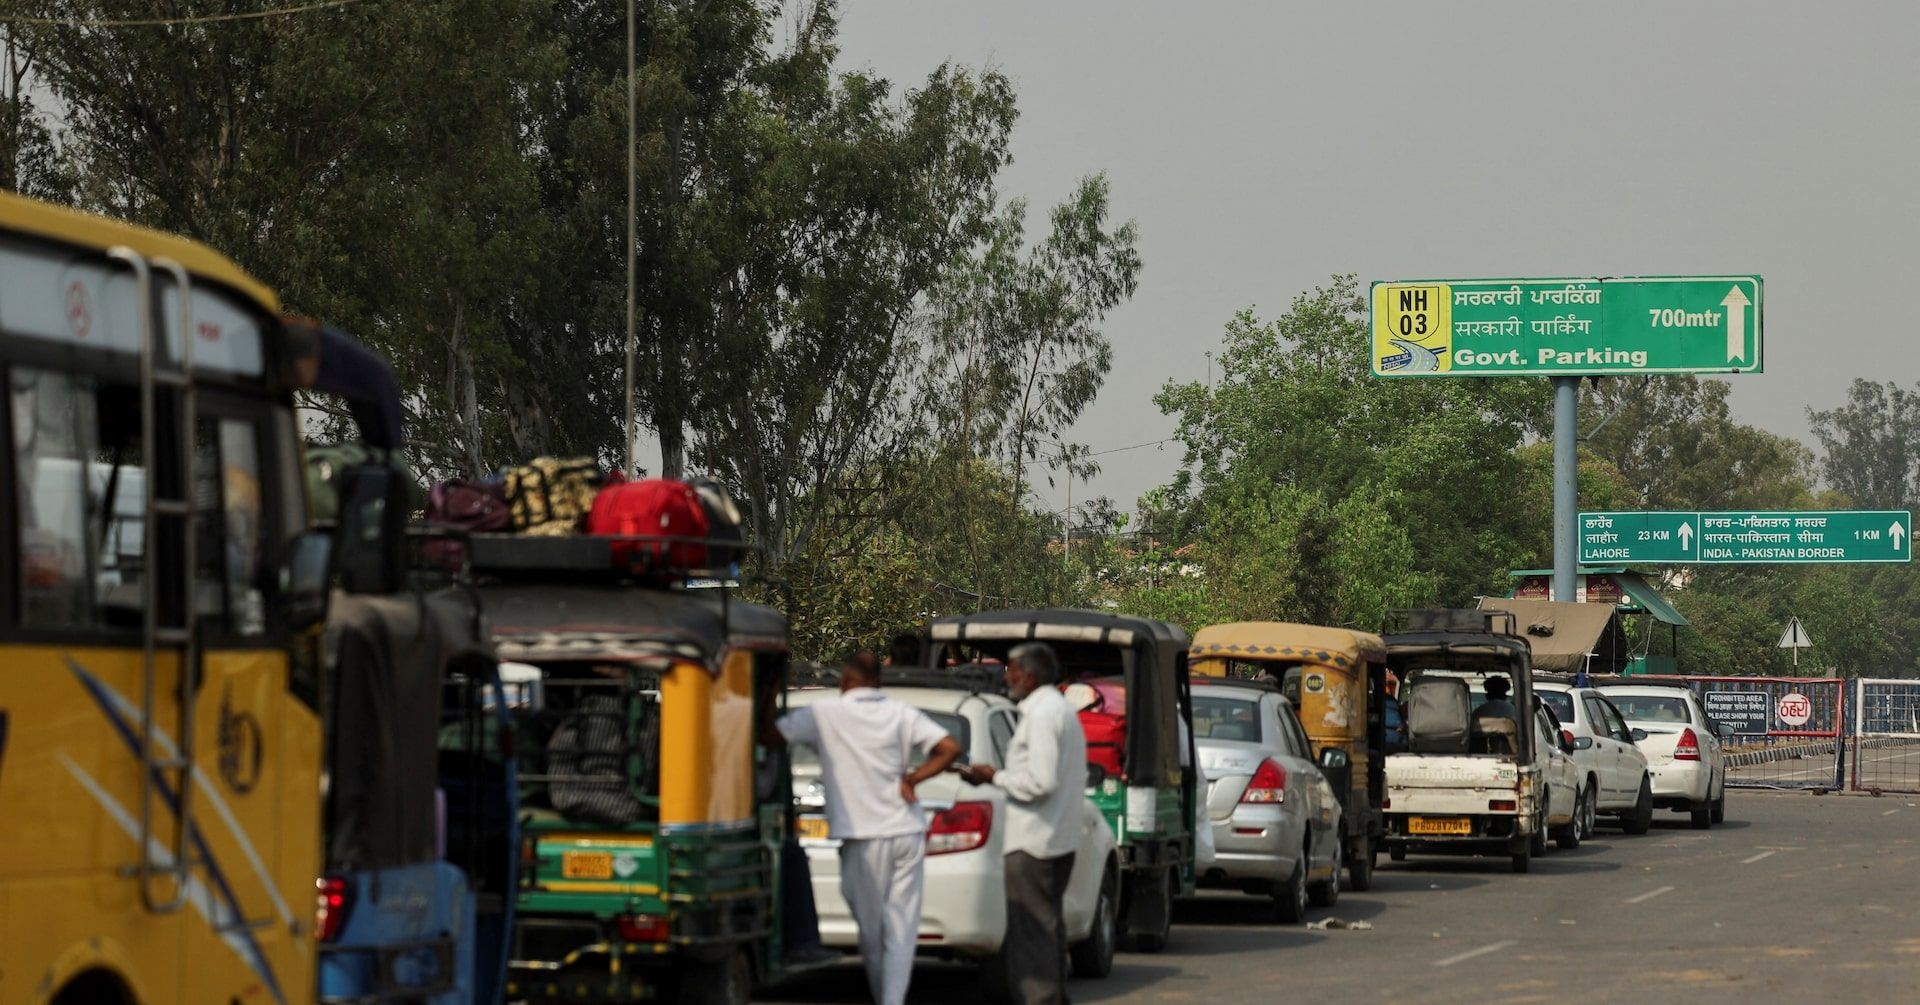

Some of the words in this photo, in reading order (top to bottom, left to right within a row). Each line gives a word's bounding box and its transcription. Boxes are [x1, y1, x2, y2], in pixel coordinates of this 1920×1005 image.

[1400, 290, 1427, 311] NH
[1454, 285, 1523, 306] ਸਰਕਾਰੀ
[1530, 284, 1602, 305] ਪਾਰਕਿੰਗ
[1400, 313, 1427, 336] 03
[1454, 316, 1523, 337] सरकारी
[1530, 313, 1593, 335] पार्किंग
[1649, 308, 1722, 328] 700mtr
[1454, 348, 1528, 366] Govt.
[1538, 347, 1648, 368] Parking
[1585, 530, 1618, 544] लाहौर
[1637, 530, 1651, 541] 23
[1652, 530, 1670, 541] KM
[1704, 530, 1791, 544] भारत-पाकिस्तान
[1796, 529, 1825, 544] सीमा
[1853, 530, 1859, 540] 1
[1862, 530, 1880, 540] KM
[1585, 548, 1630, 559] LAHORE
[1703, 548, 1734, 558] INDIA
[1741, 548, 1795, 558] PAKISTAN
[1797, 547, 1845, 558] BORDER
[1709, 694, 1745, 702] PROHIBITED
[1746, 694, 1764, 702] AREA
[1707, 712, 1731, 720] PLEASE
[1731, 712, 1748, 720] SHOW
[1748, 713, 1765, 721] YOUR
